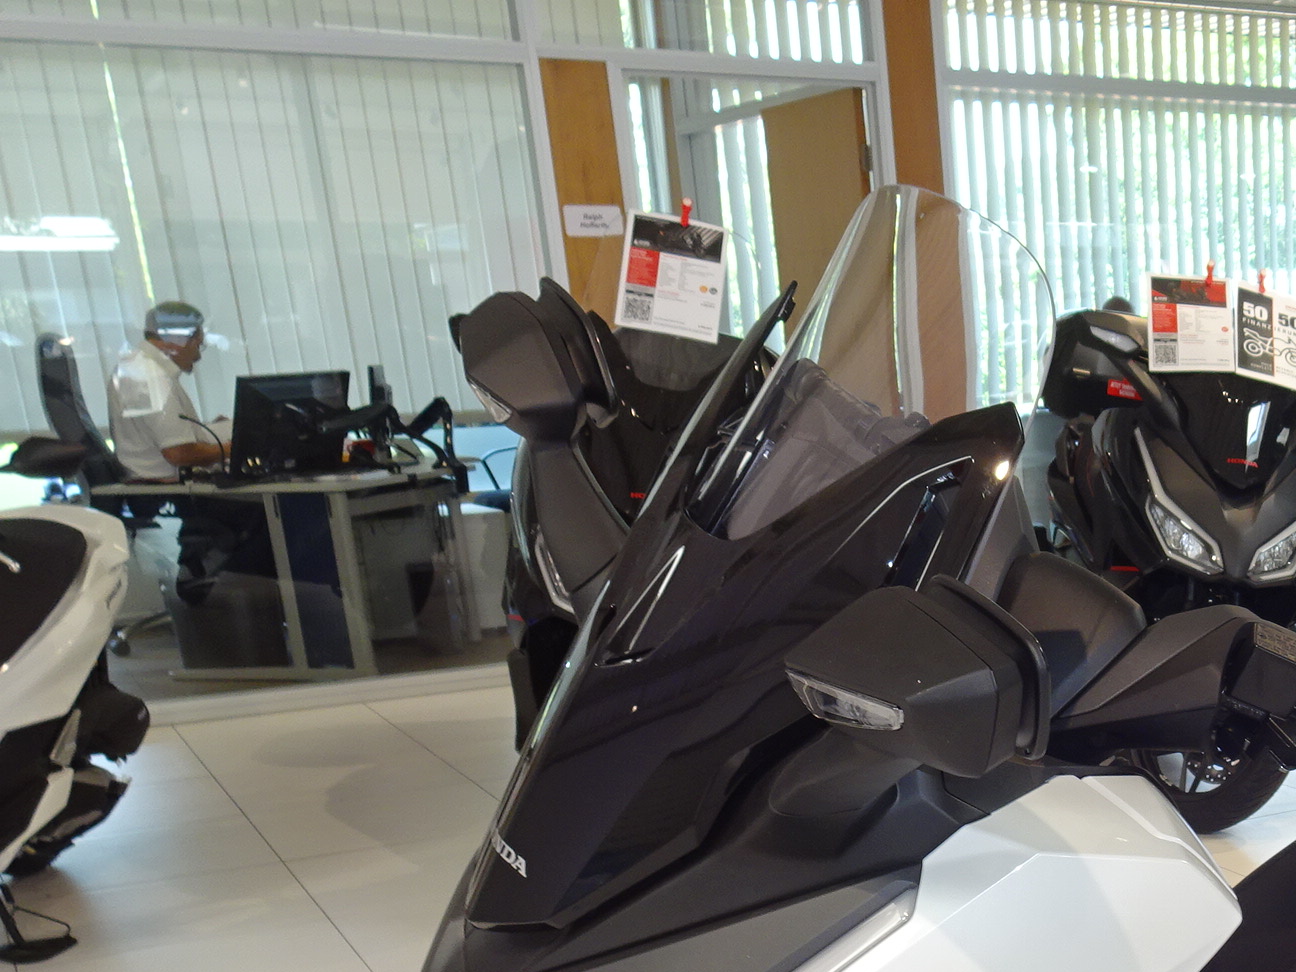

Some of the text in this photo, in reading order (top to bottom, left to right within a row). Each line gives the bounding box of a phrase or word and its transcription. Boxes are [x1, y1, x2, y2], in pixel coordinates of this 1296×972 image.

[1243, 301, 1269, 322] 50
[1226, 457, 1260, 468] HONDA
[492, 829, 528, 879] NDA
